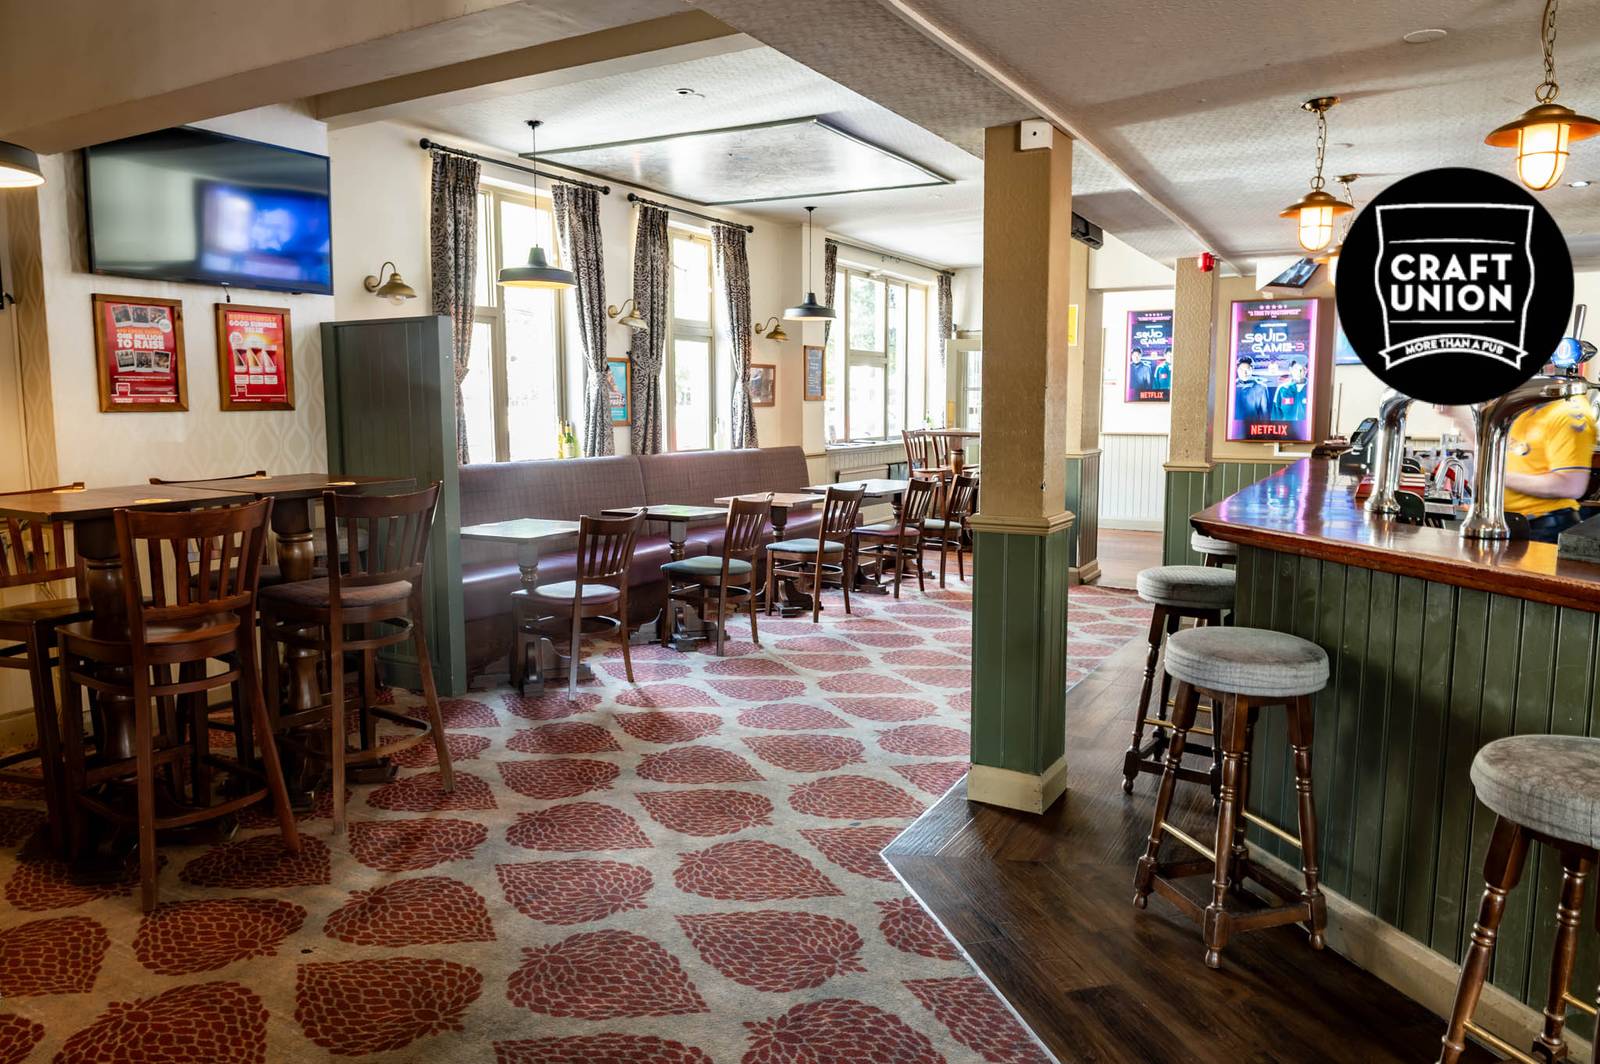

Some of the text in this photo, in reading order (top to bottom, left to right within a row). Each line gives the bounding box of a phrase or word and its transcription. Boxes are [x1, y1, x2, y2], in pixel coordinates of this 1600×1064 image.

[1133, 328, 1163, 340] SQUID
[1241, 328, 1288, 345] SQUID
[116, 339, 165, 350] TO RAISE
[1251, 342, 1294, 356] GAME
[1140, 391, 1164, 399] NETFLIX
[1250, 424, 1288, 436] NETFLIX
